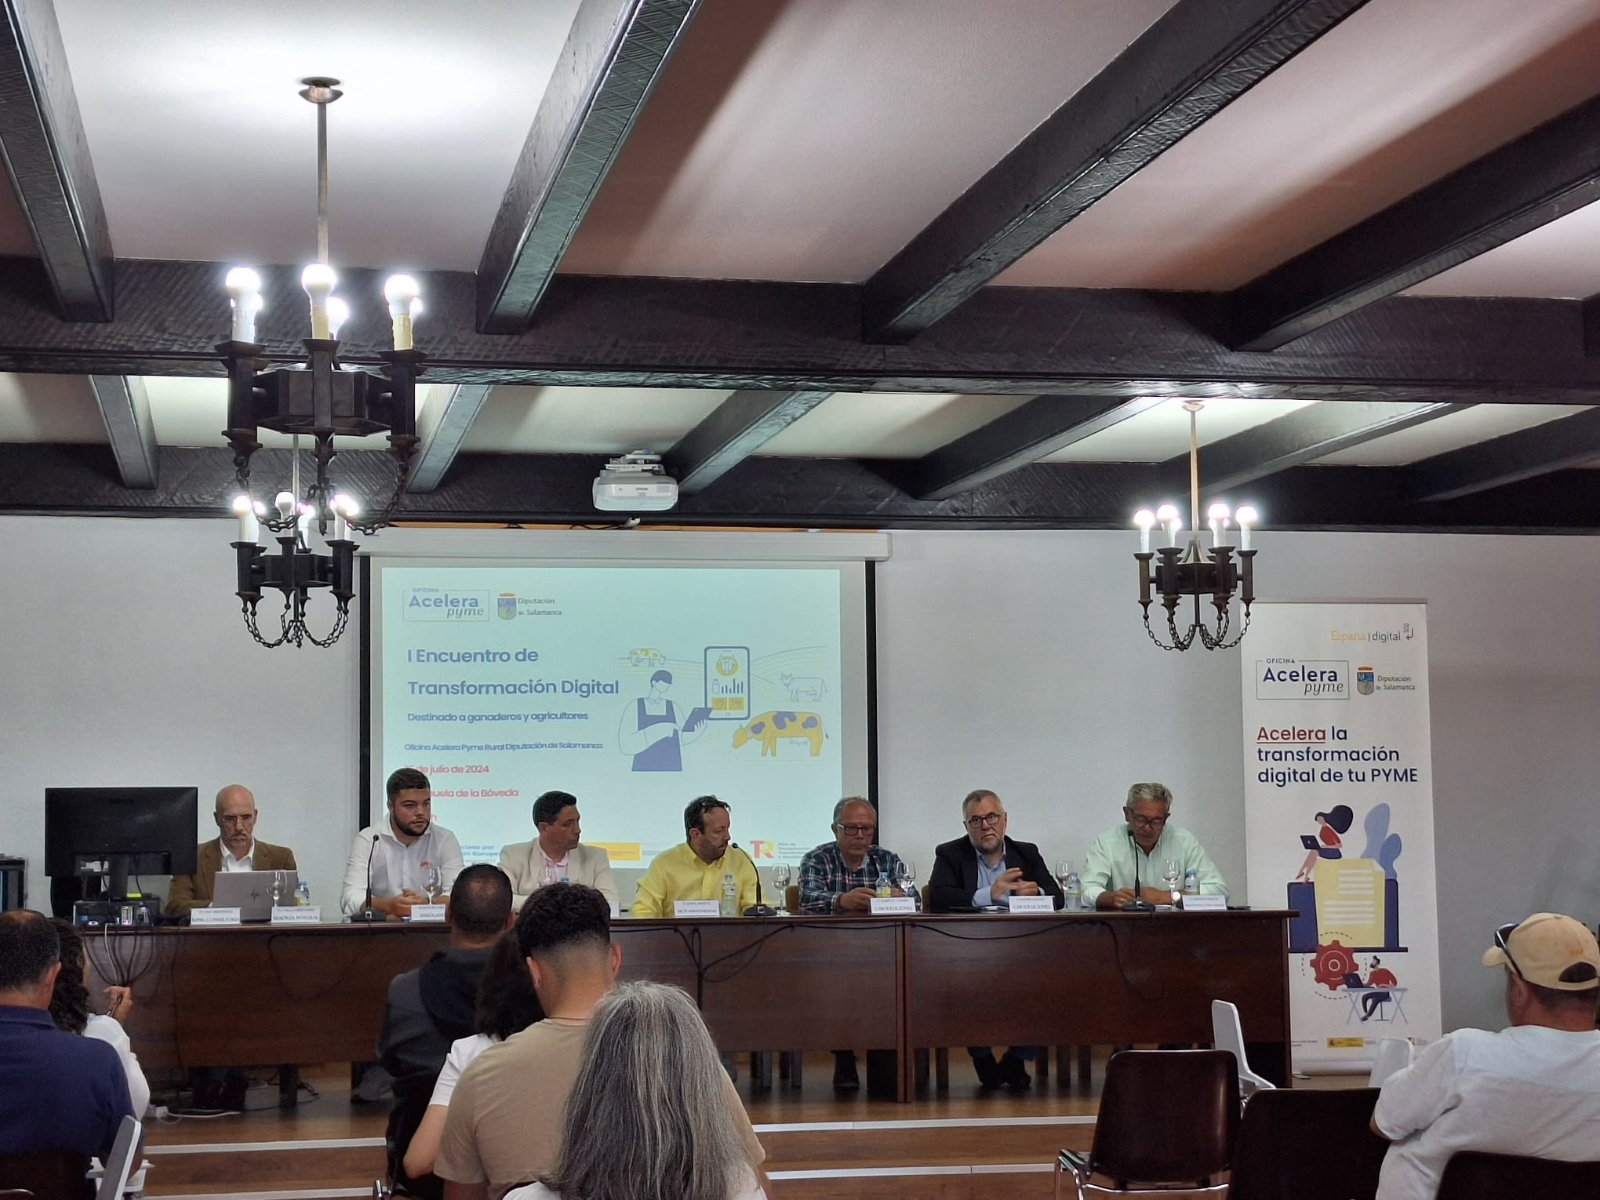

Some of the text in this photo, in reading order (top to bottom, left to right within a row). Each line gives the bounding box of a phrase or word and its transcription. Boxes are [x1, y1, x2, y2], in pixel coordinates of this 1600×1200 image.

[408, 594, 478, 608] Acelera
[518, 597, 556, 606] Diputación
[446, 608, 484, 619] pyme
[1372, 630, 1401, 643] digital
[408, 648, 539, 662] I Encuentro de
[1262, 665, 1338, 682] Acelera
[1378, 675, 1411, 684] Diputación
[408, 680, 619, 698] Transformación Digital
[1304, 682, 1344, 696] pyme
[408, 712, 458, 722] Destinado
[468, 712, 522, 723] ganaderos
[524, 714, 529, 722] y
[531, 711, 588, 722] agricultores
[1256, 726, 1348, 741] Acelera la
[462, 744, 484, 753] Pyme
[505, 742, 547, 751] Diputación
[1258, 746, 1400, 762] transformación
[429, 765, 450, 776] julio
[450, 765, 464, 773] de
[465, 765, 490, 774] 2024
[1258, 768, 1418, 787] digital de tu PYME
[456, 789, 469, 798] de
[470, 789, 480, 798] la
[481, 788, 519, 798] Bóveda
[750, 840, 774, 858] TR
